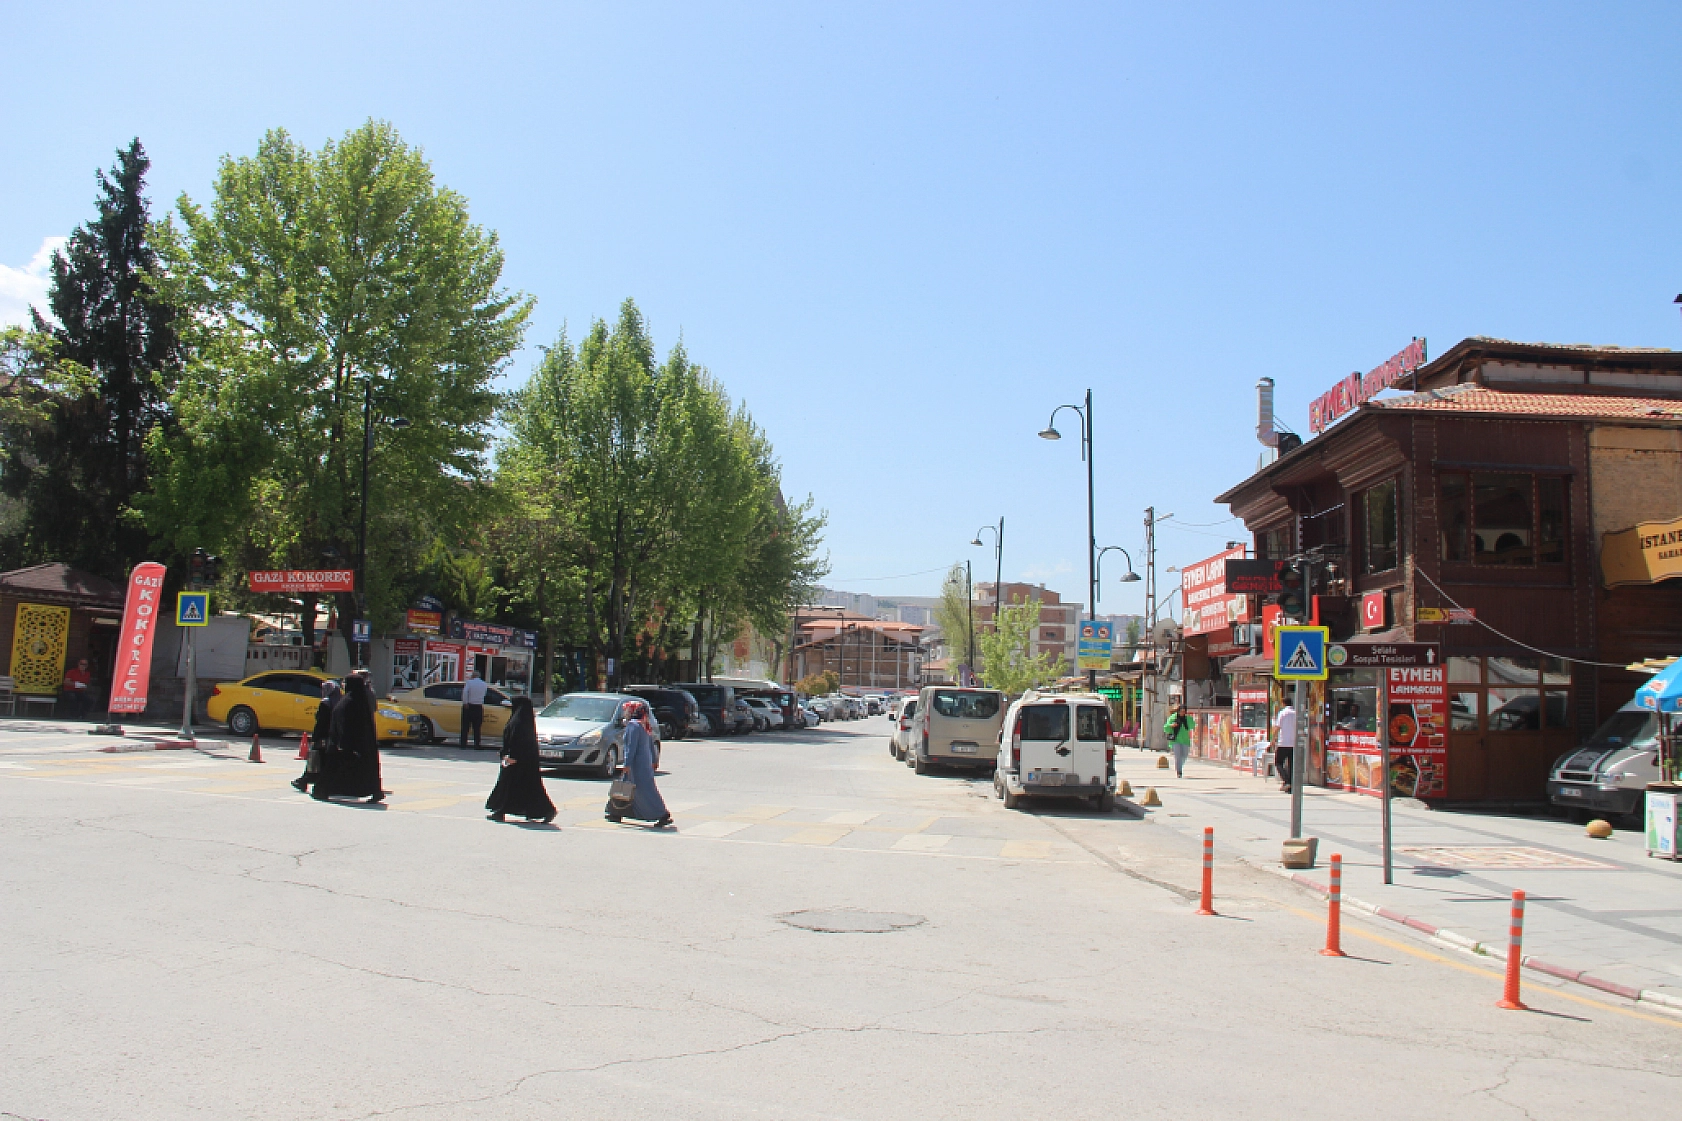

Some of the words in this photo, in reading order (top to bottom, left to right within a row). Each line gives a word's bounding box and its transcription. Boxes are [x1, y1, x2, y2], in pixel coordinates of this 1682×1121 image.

[1309, 371, 1361, 433] EYMEN
[287, 571, 351, 585] KOKOREÇ
[123, 588, 154, 695] KOKOREÇ
[1390, 667, 1443, 682] EYMEN
[1390, 685, 1443, 695] LAHMACUN
